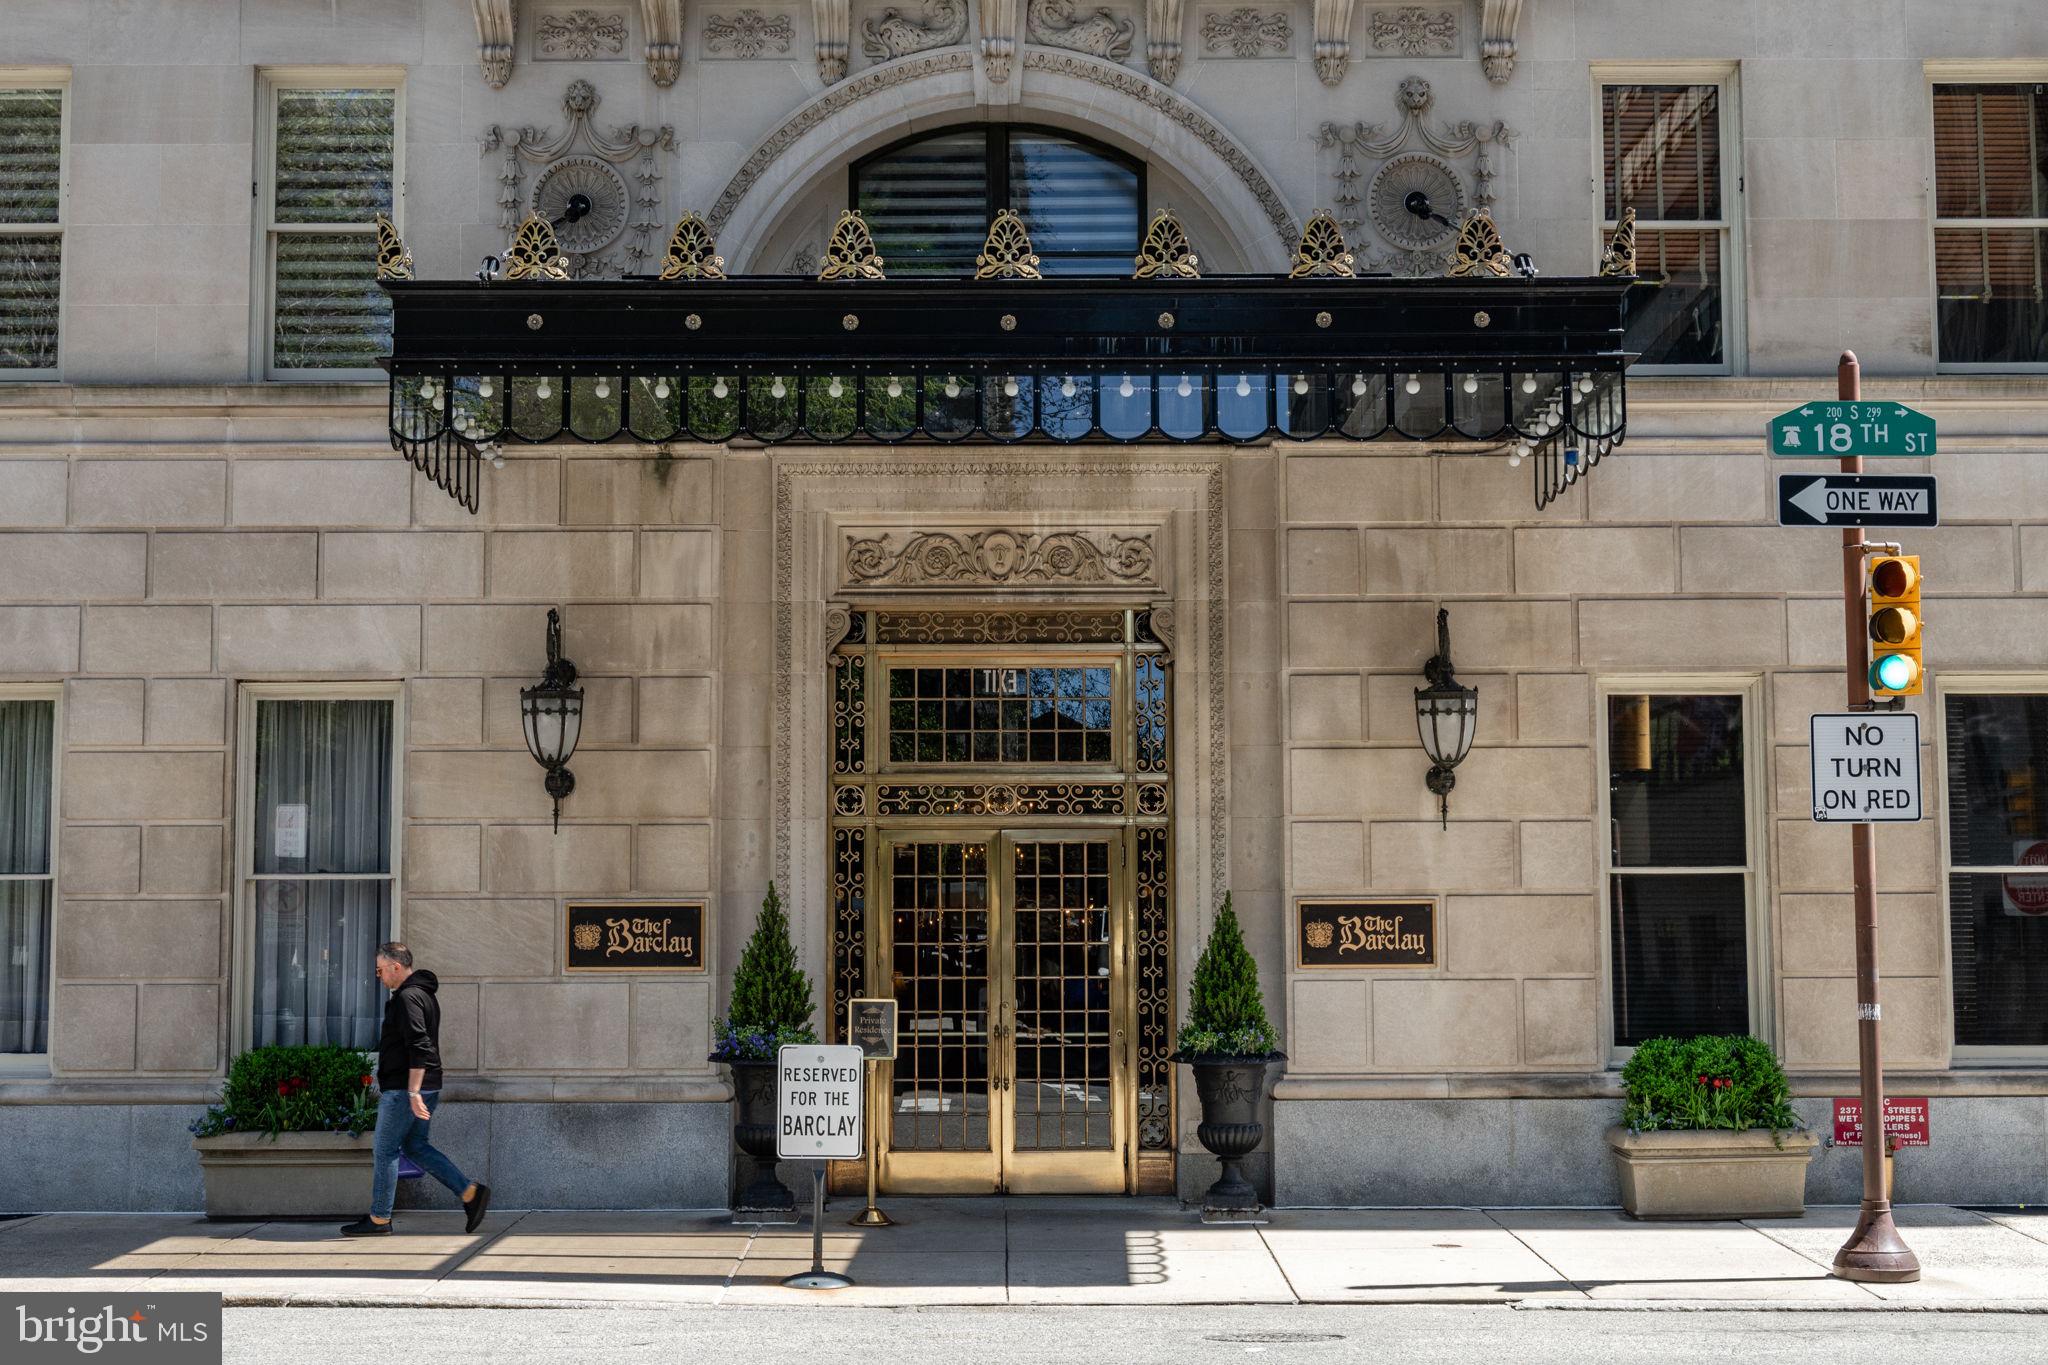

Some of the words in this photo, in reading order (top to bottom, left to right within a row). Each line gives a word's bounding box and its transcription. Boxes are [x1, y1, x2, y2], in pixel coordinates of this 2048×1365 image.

[1827, 407, 1842, 418] 200
[1850, 405, 1859, 420] S
[1867, 407, 1881, 418] 299
[1814, 423, 1889, 452] 18TH
[1905, 433, 1928, 452] ST
[1827, 491, 1870, 510] ONE
[1879, 491, 1919, 511] WAY
[1845, 726, 1884, 746] NO
[1830, 757, 1901, 777] TURN
[1823, 790, 1856, 809] ON
[1867, 789, 1911, 809] RED
[632, 918, 662, 935] The
[1364, 915, 1394, 932] The
[606, 918, 693, 958] Barclay
[1338, 915, 1426, 955] Barclay
[854, 1025, 892, 1033] Residence
[784, 1068, 857, 1082] RESERVED
[791, 1091, 817, 1105] FOR
[824, 1091, 850, 1105] THE
[783, 1115, 857, 1136] BARCLAY
